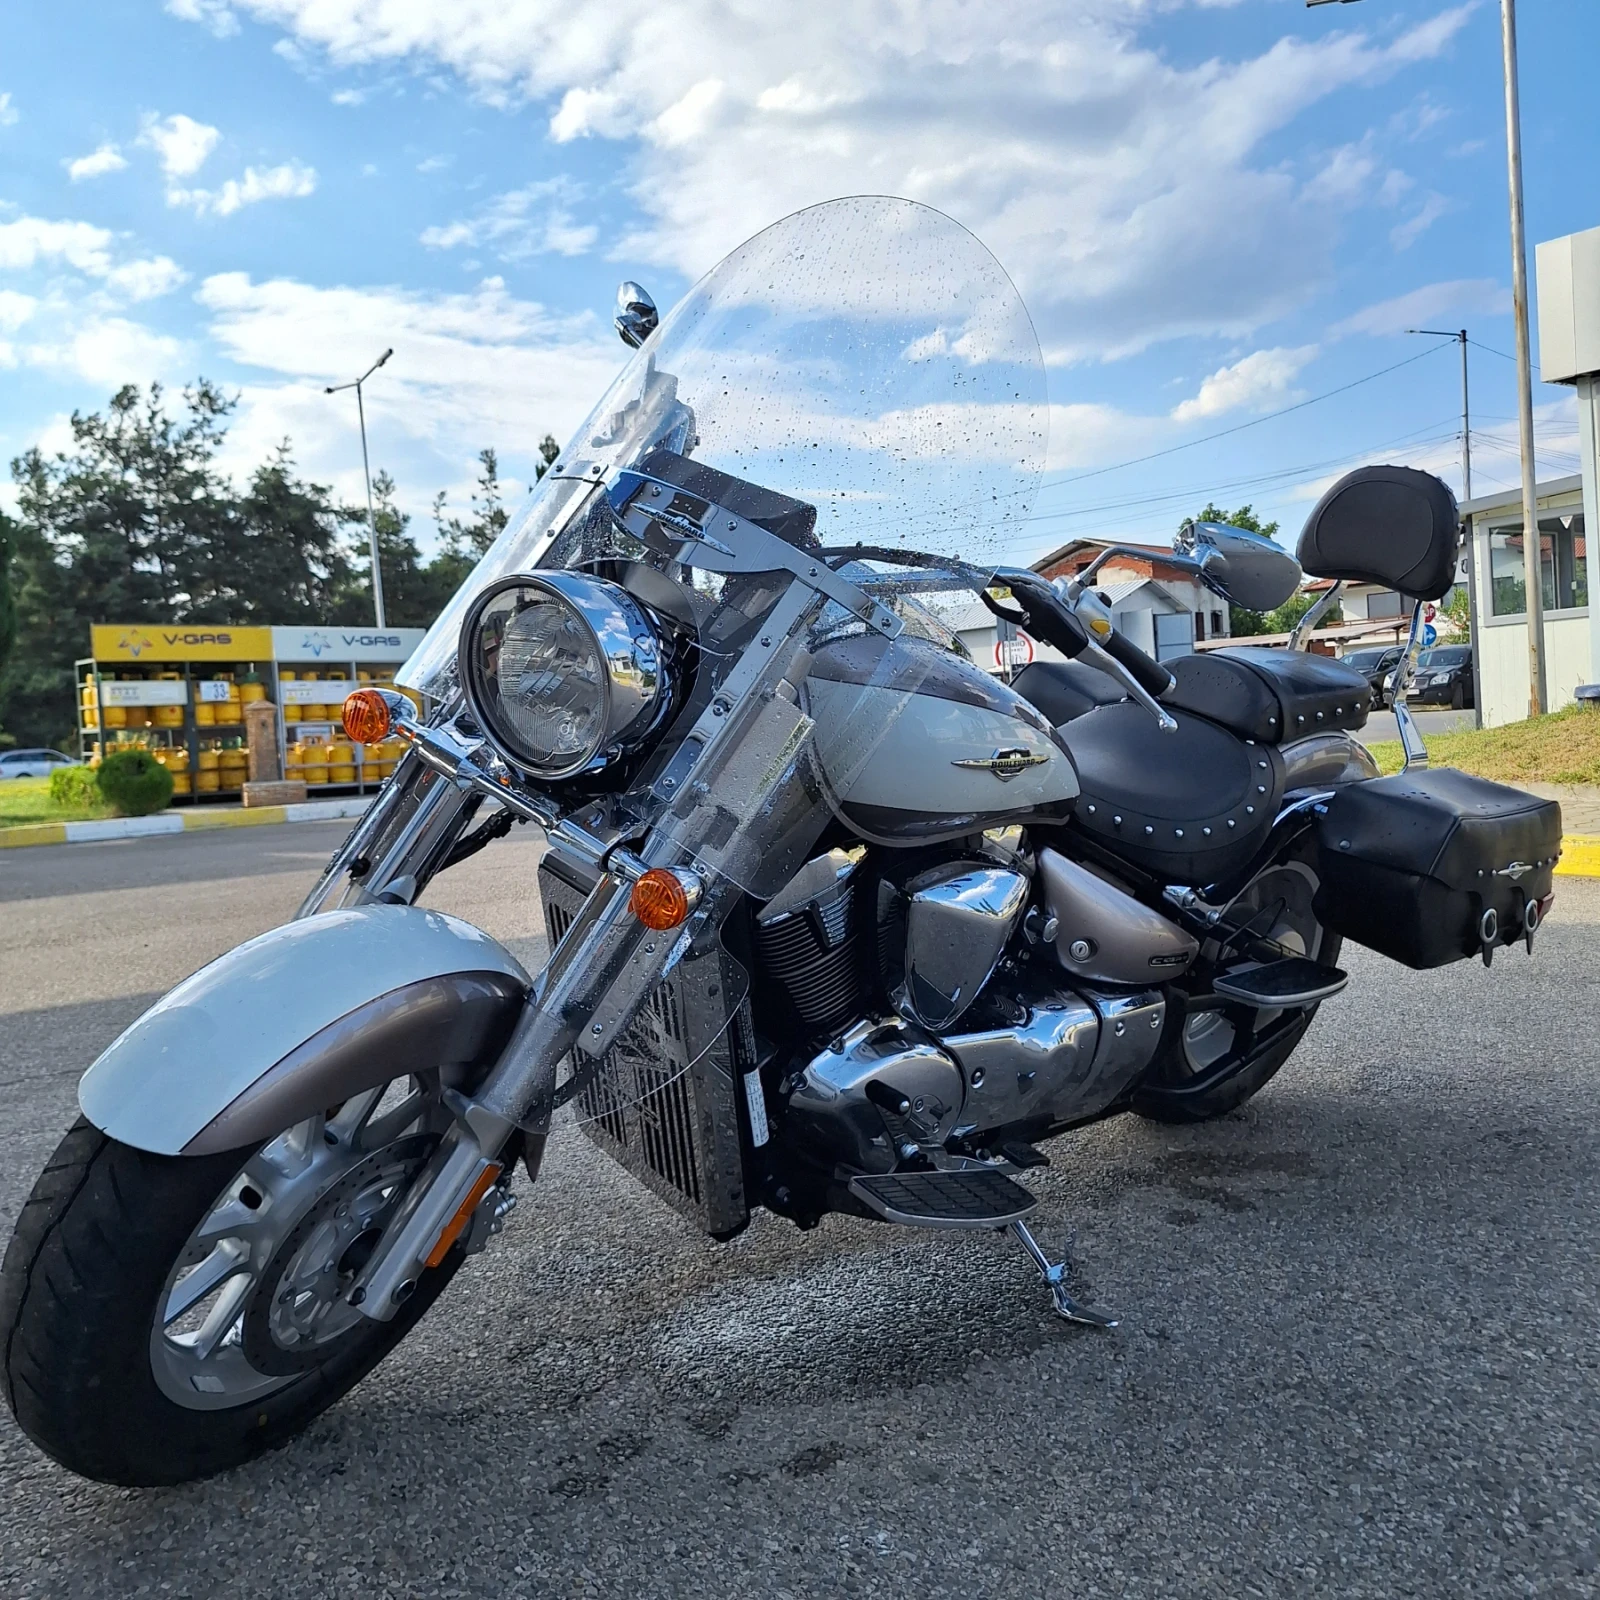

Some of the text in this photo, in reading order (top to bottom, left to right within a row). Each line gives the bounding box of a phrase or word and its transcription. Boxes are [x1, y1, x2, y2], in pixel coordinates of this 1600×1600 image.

[654, 510, 706, 540] BOULEVARD
[162, 632, 232, 646] V-GAS
[341, 634, 402, 647] V-GAS
[990, 758, 1036, 769] BOULEVARD
